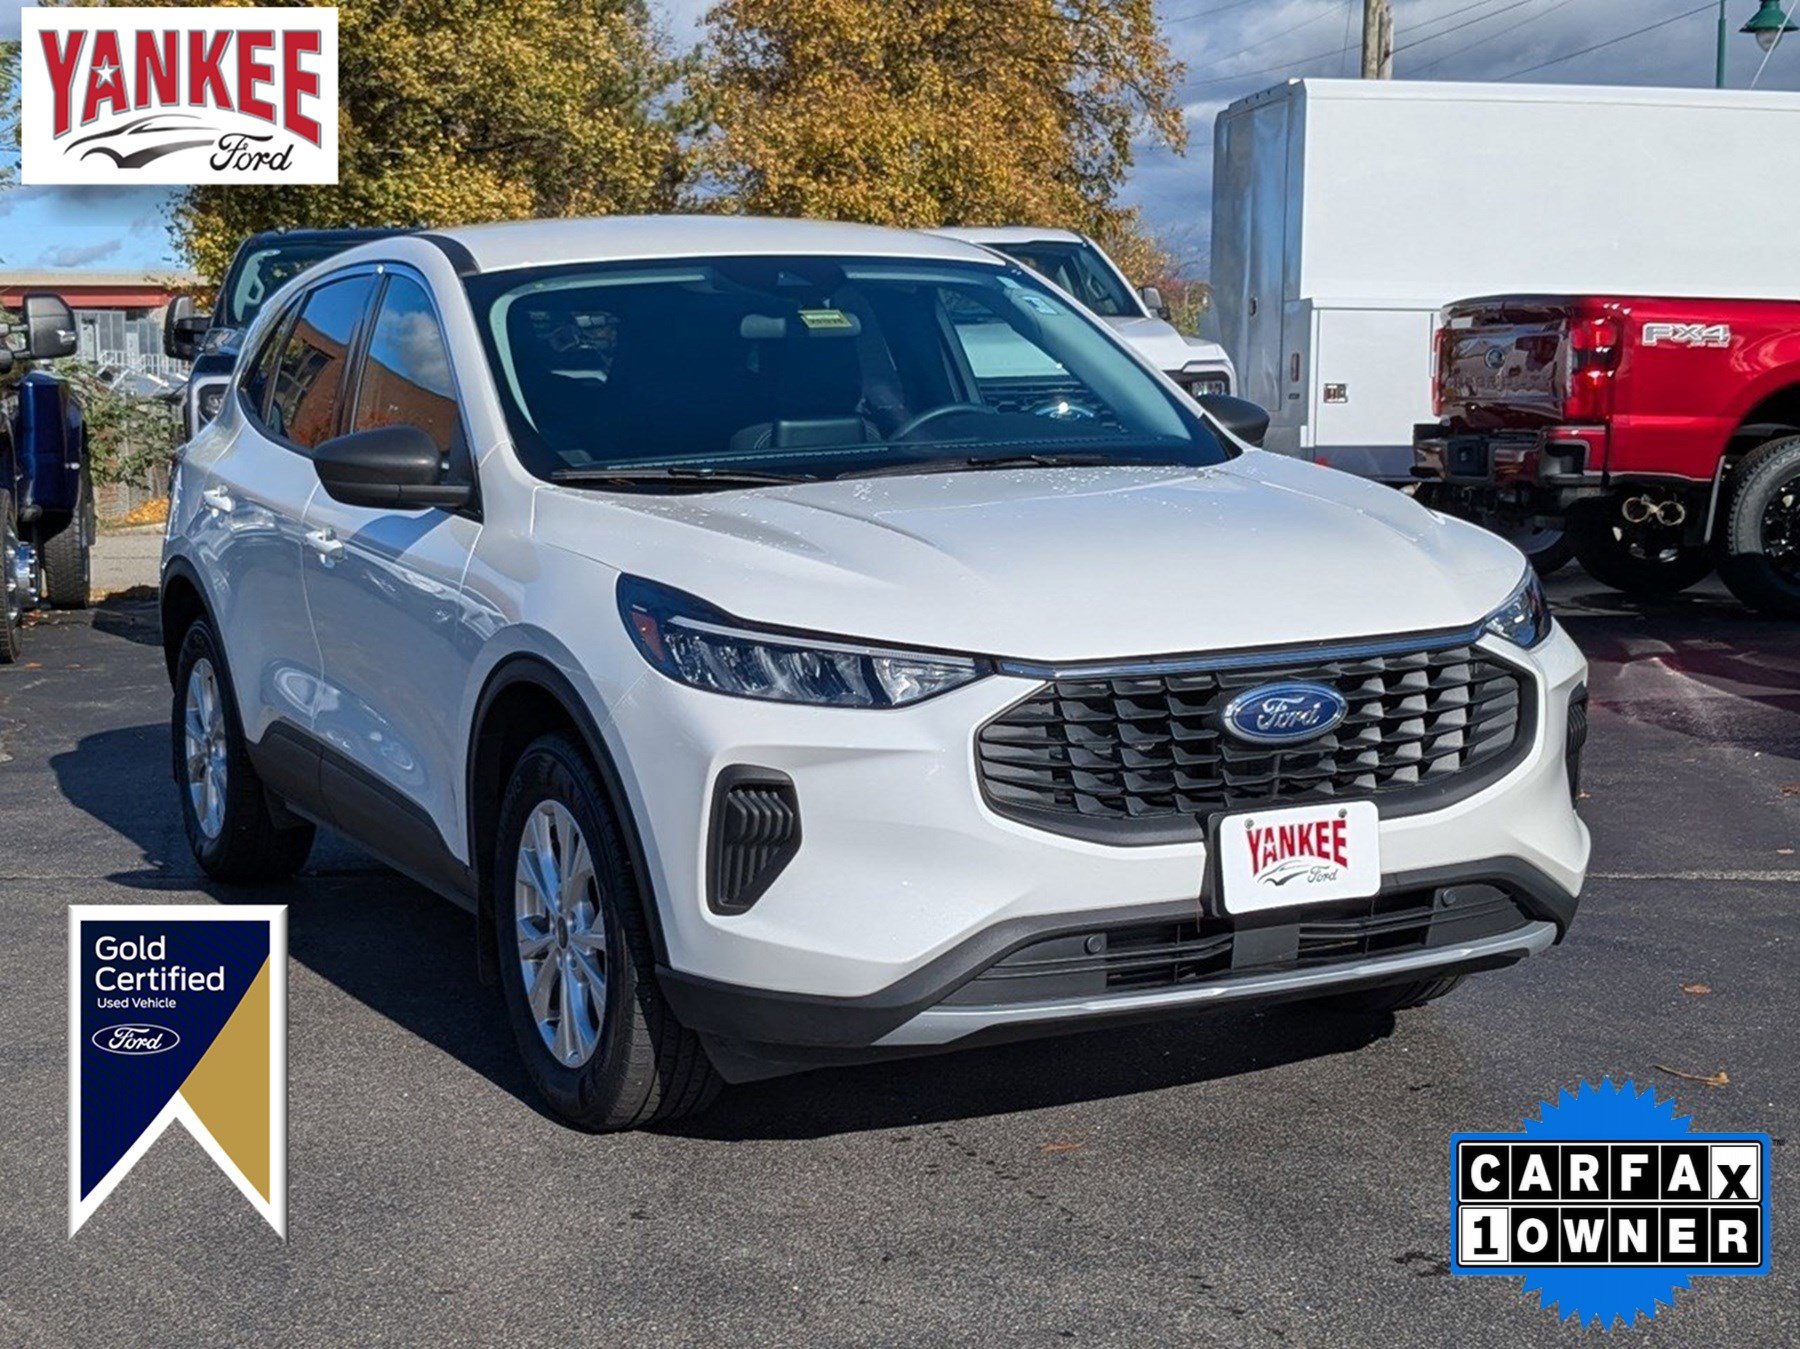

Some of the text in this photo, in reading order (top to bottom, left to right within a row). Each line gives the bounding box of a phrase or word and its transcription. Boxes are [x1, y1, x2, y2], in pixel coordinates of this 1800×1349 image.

[1642, 323, 1730, 346] FX4
[1257, 697, 1320, 730] Ford
[1246, 819, 1349, 876] YANKEE
[1306, 866, 1338, 883] Ford
